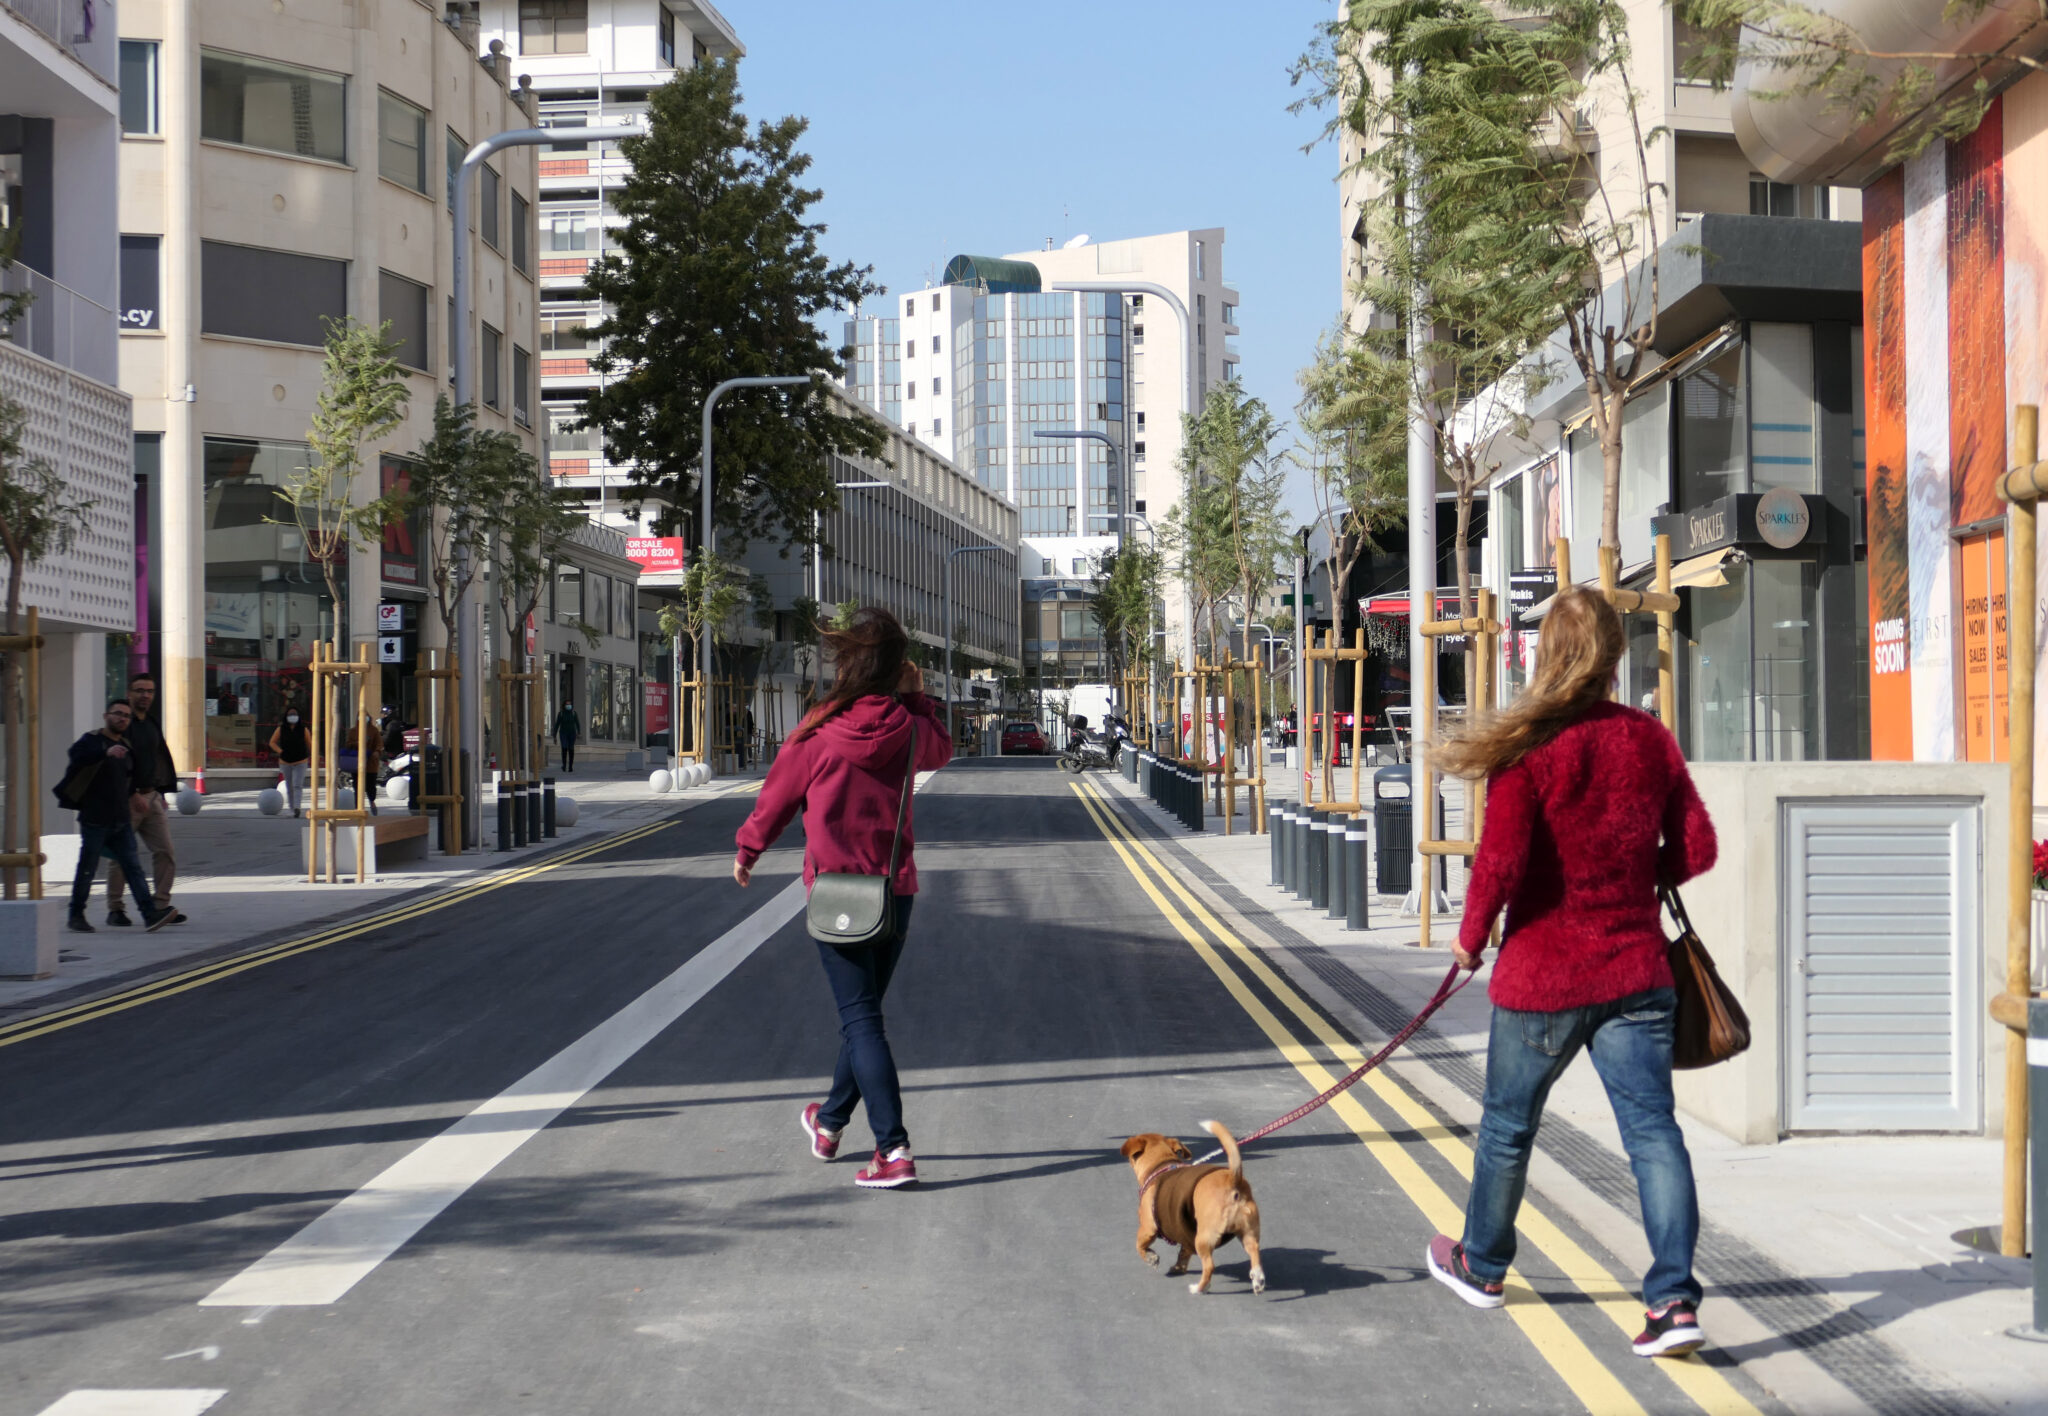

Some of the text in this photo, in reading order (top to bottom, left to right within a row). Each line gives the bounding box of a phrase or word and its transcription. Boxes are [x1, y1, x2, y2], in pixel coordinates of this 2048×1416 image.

[118, 308, 154, 327] .cy
[1760, 511, 1807, 525] SPARKLES
[1690, 512, 1725, 550] SPARKLES
[641, 540, 663, 548] SALE
[650, 548, 675, 558] 8200
[1510, 589, 1534, 600] Nakis
[1965, 597, 1989, 616] HIRING
[1874, 617, 1905, 643] COMING
[1913, 614, 1949, 641] FIRST
[1968, 619, 1987, 637] NOW
[1995, 615, 2007, 634] NO
[1875, 642, 1905, 675] SOON
[1969, 647, 1987, 663] SALES
[1996, 645, 2008, 661] SAL
